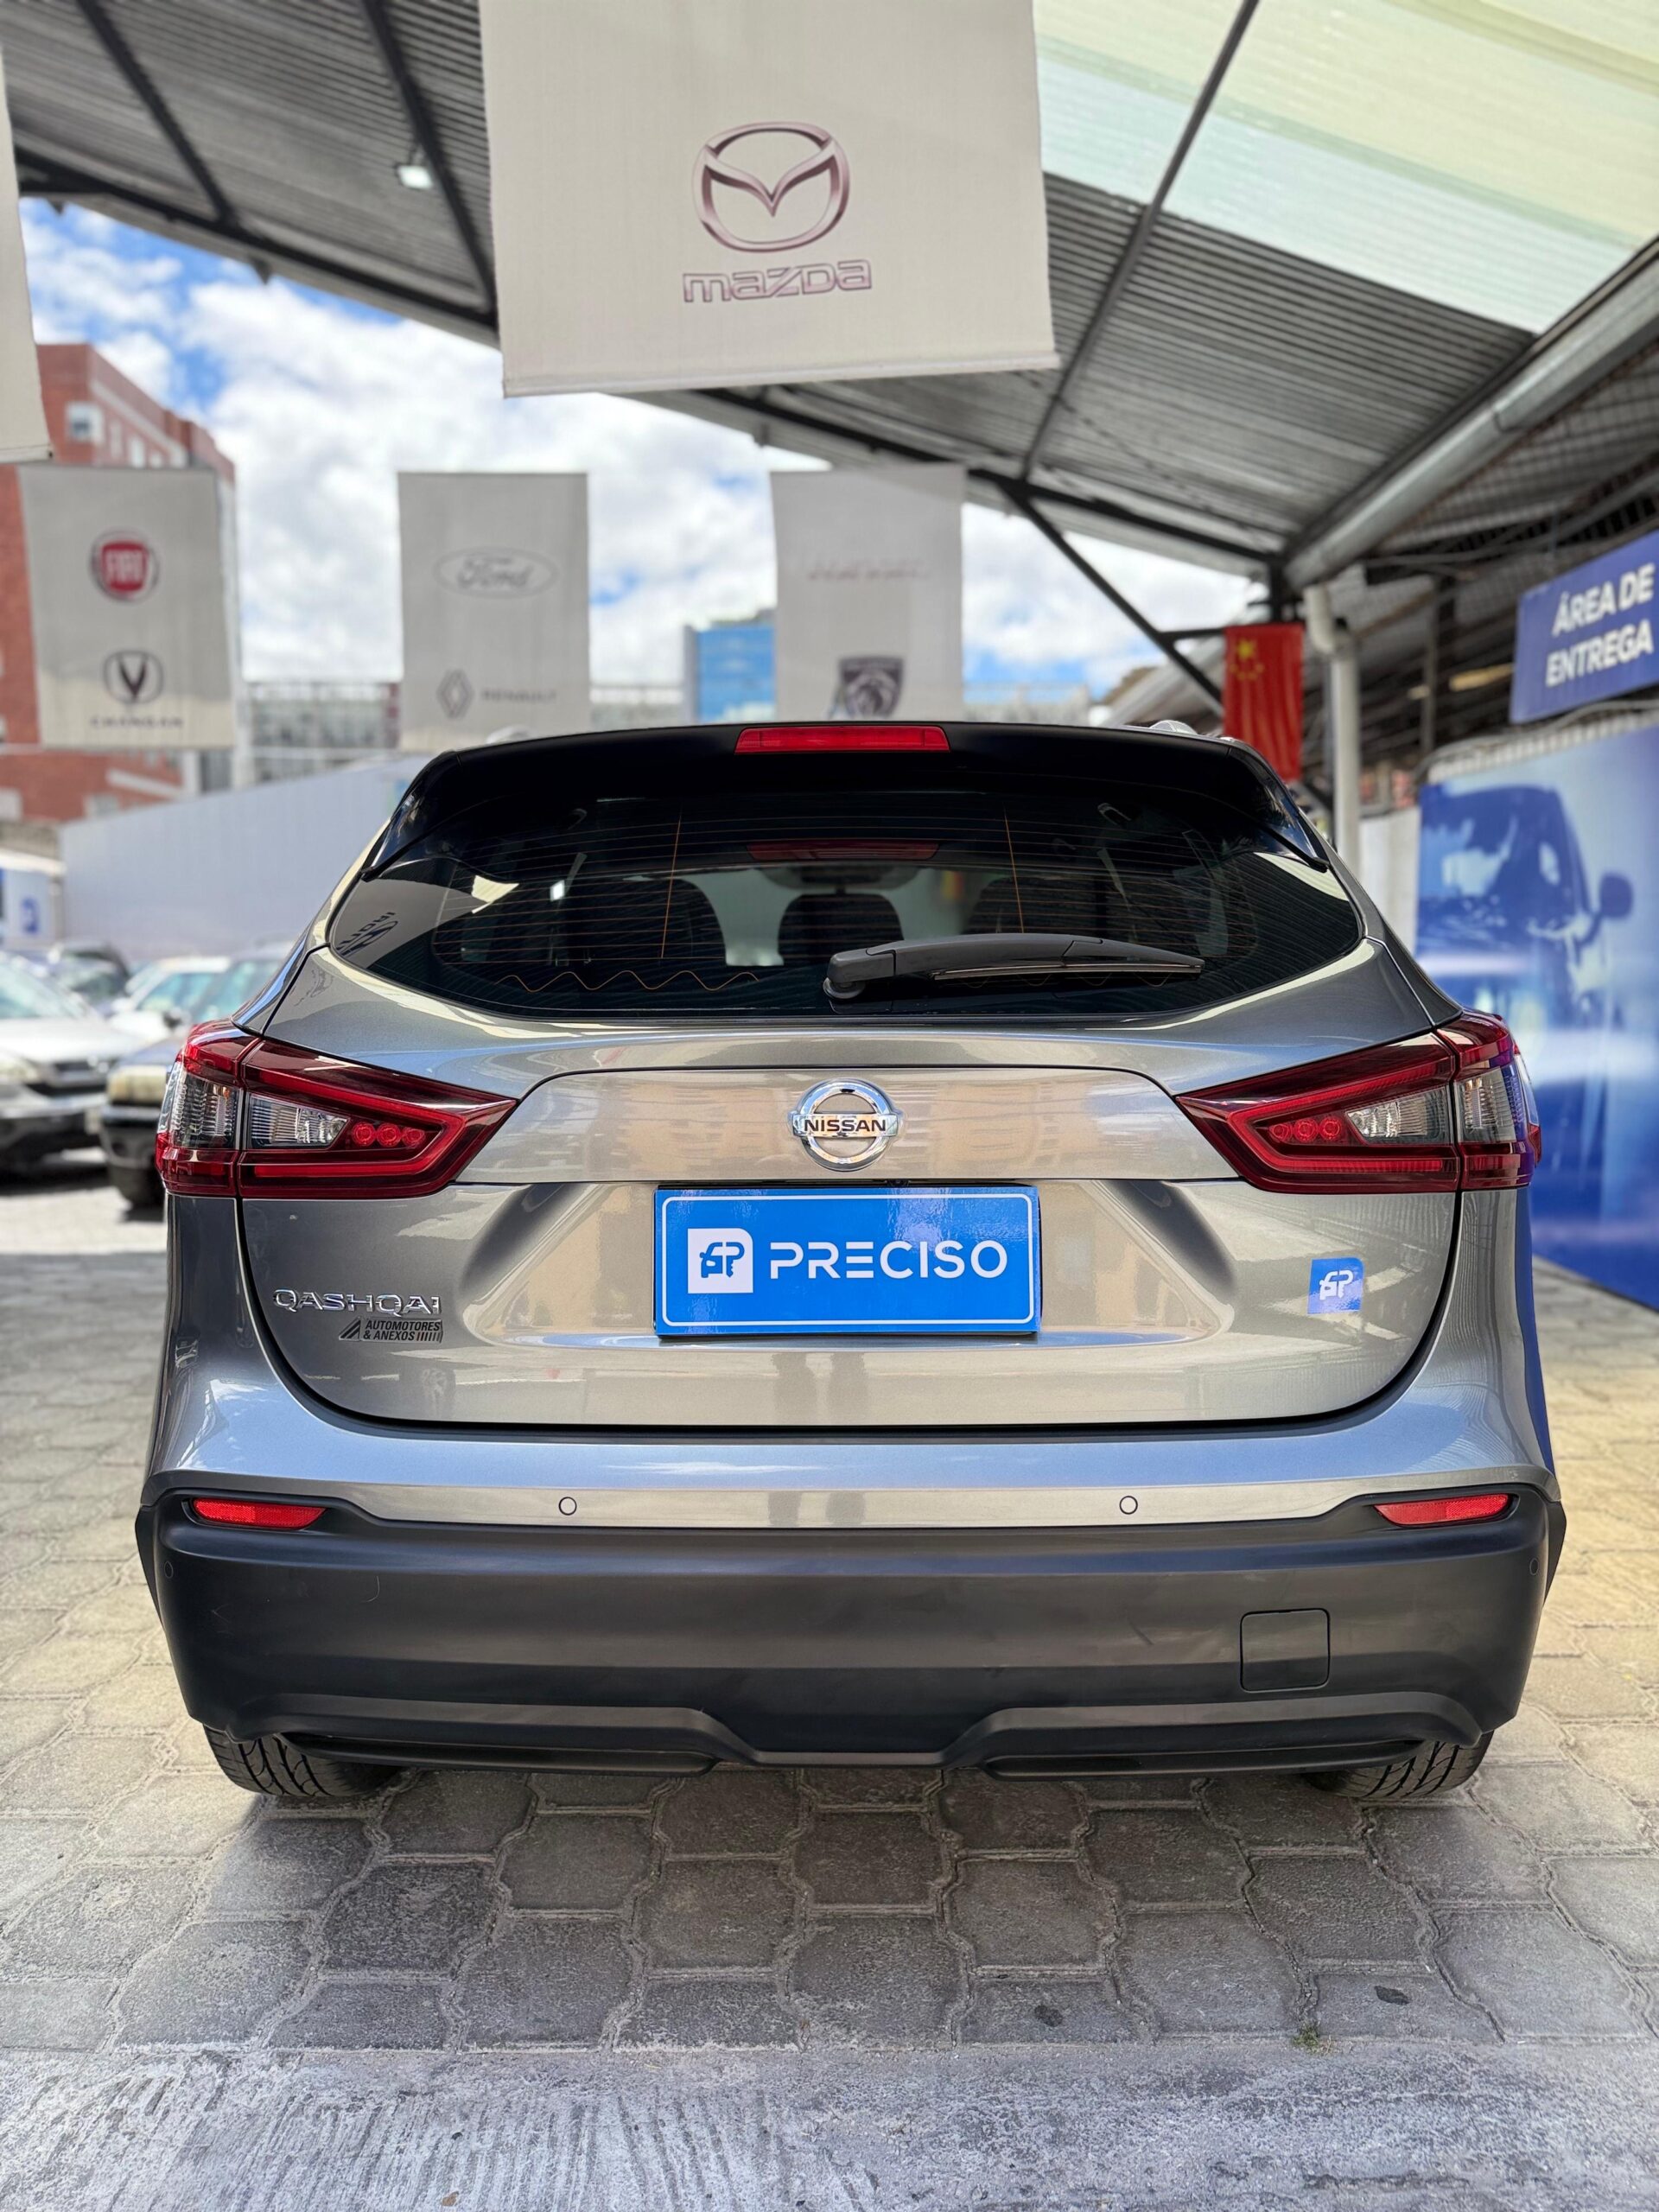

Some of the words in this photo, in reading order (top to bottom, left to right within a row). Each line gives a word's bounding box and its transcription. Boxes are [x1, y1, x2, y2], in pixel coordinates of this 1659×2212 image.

[1552, 581, 1617, 637] ÁREA
[1618, 563, 1655, 610] DE
[1545, 619, 1654, 688] ENTREGA
[804, 1120, 886, 1132] NISSAN
[770, 1240, 1007, 1280] PRECISO
[274, 1288, 442, 1317] QASHQAI
[363, 1330, 371, 1339] &
[373, 1331, 415, 1341] ANEXOS
[365, 1320, 440, 1332] AUTOMOTORES
